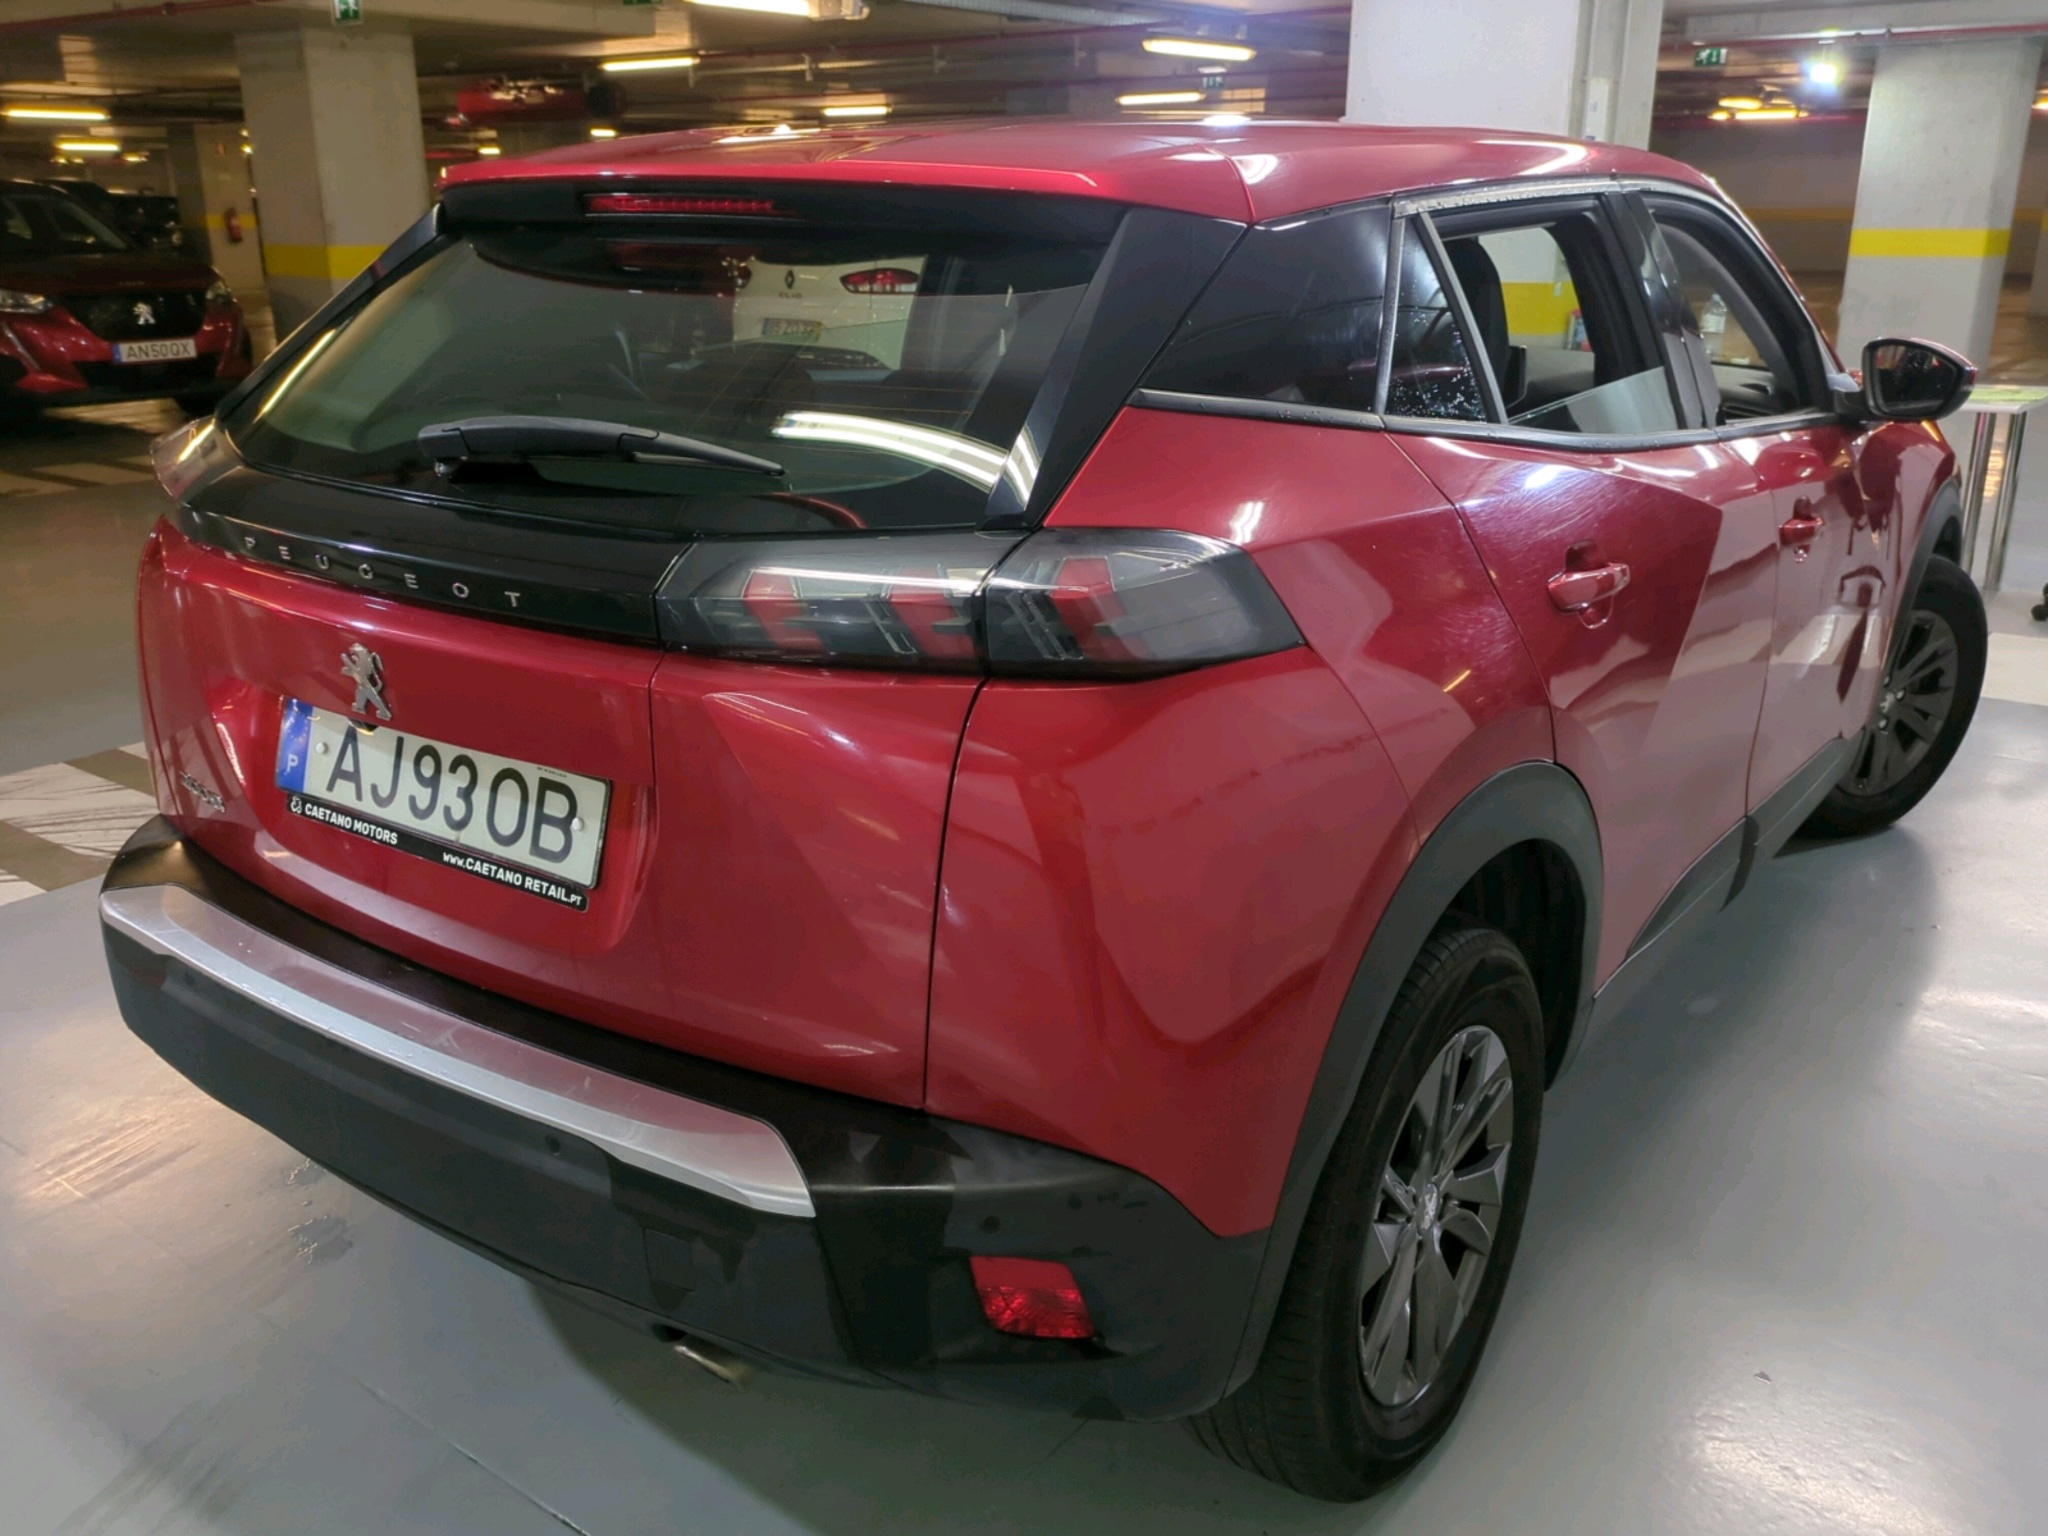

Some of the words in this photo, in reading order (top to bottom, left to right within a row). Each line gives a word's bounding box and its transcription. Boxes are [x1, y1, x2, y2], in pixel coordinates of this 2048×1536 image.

[244, 536, 522, 608] PEUGEOT
[285, 753, 299, 775] P
[304, 803, 352, 829] CAETANO
[353, 819, 399, 845] MOTORS
